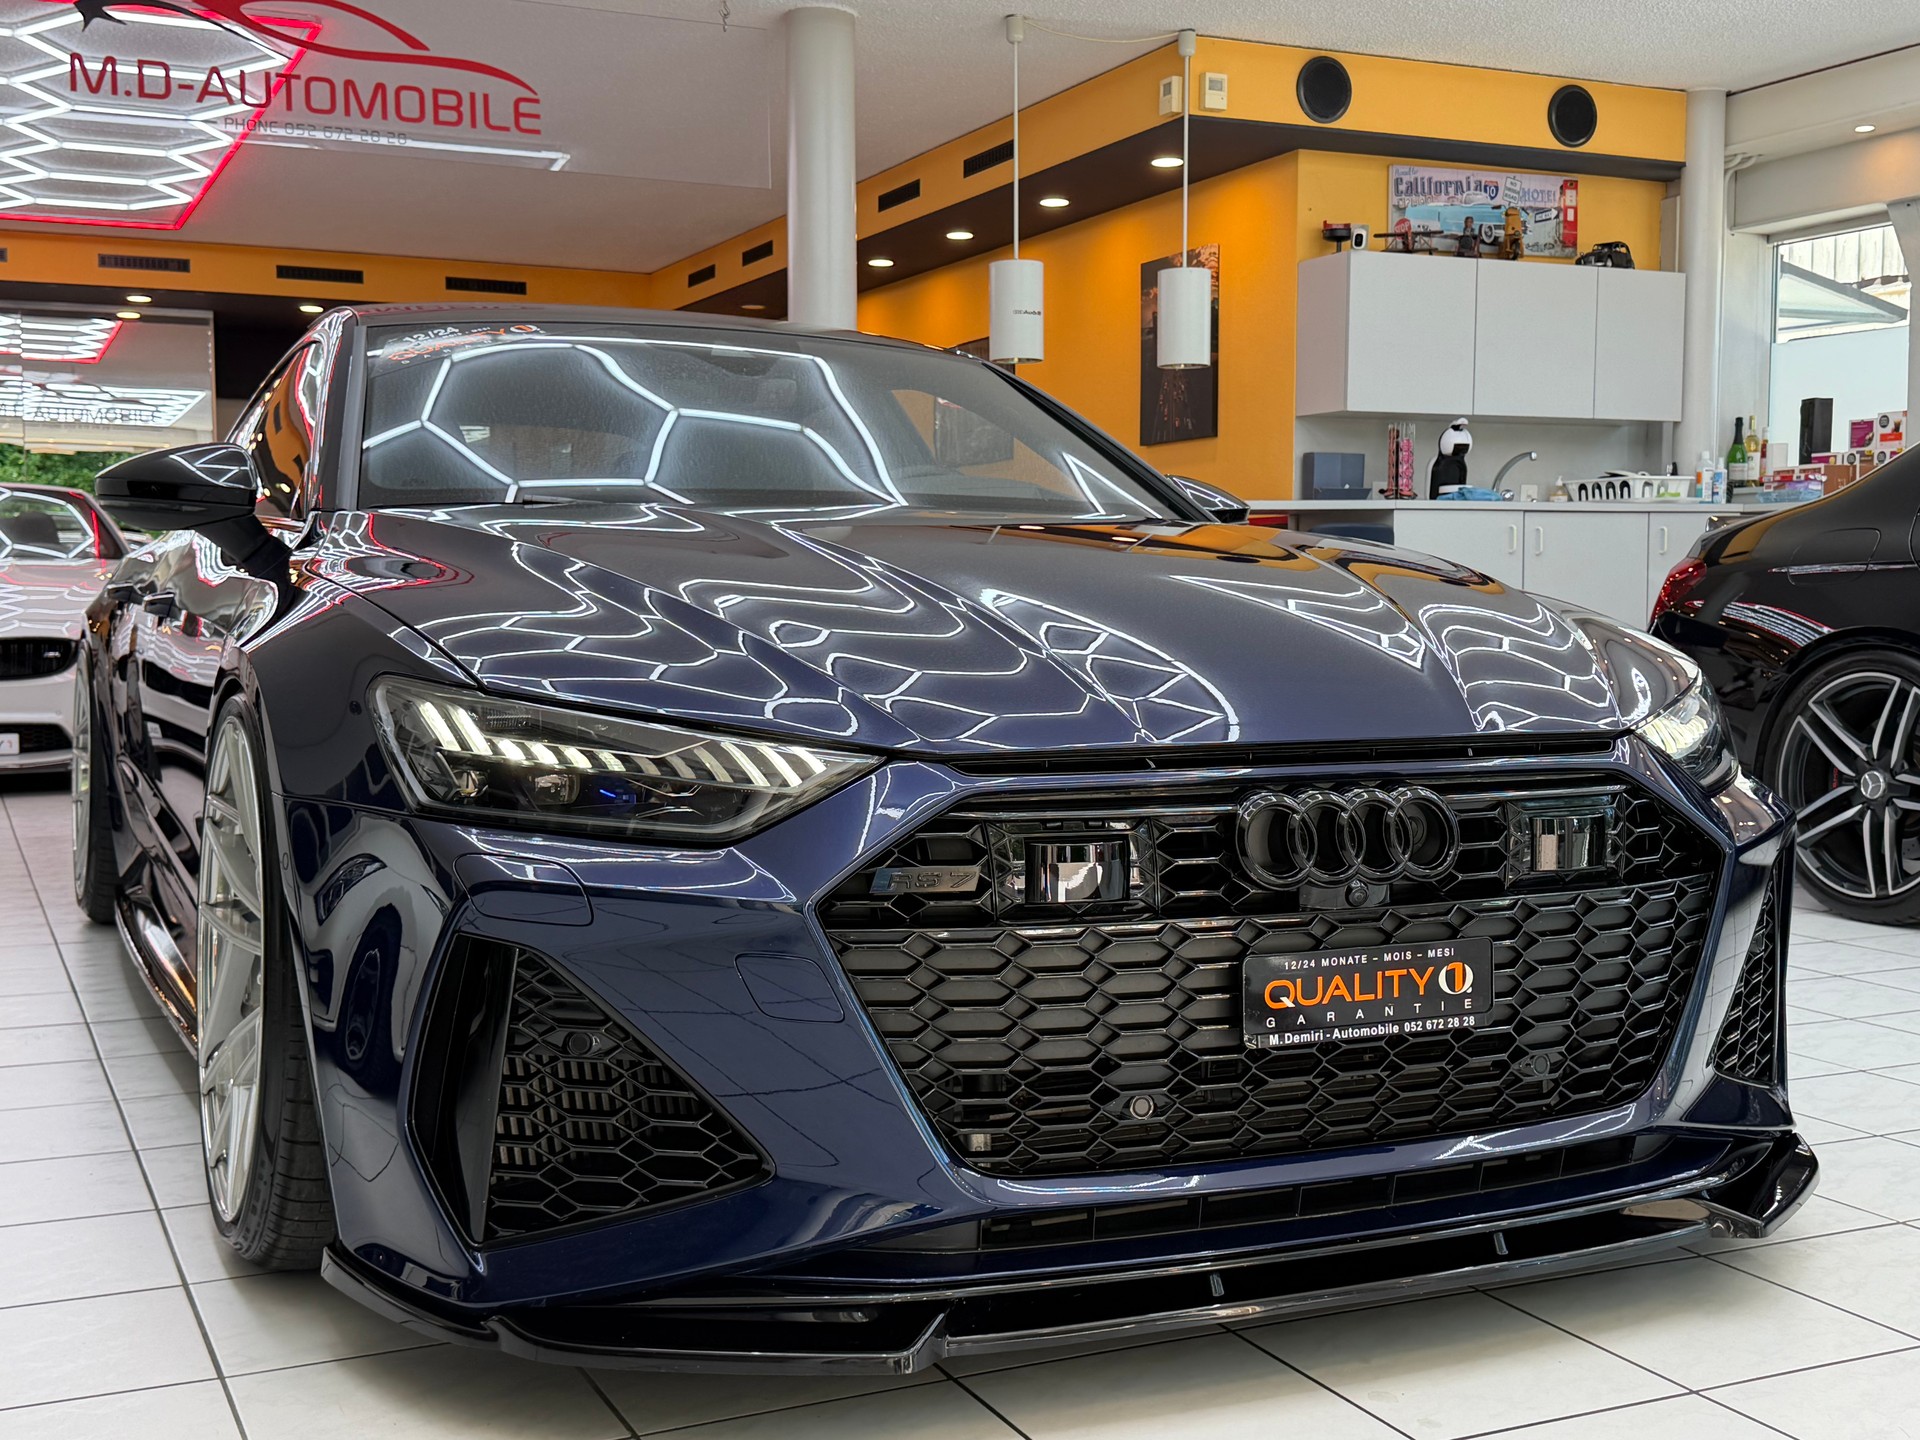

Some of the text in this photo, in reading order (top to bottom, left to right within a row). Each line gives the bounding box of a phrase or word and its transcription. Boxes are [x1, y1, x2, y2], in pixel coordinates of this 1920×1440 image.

[69, 52, 542, 136] M.D-AUTOMOBILE
[224, 117, 408, 145] PHONE 052 672 28 28
[1394, 176, 1483, 198] California
[1486, 186, 1496, 198] 10
[1394, 220, 1410, 233] STOP
[402, 327, 459, 344] 12/24
[1284, 959, 1316, 970] 12/24
[1321, 954, 1368, 967] MONATE
[1383, 950, 1412, 962] MOIS
[1428, 947, 1455, 958] MESI
[1264, 966, 1435, 1009] QUALITY
[1266, 998, 1472, 1028] GARANTIE
[1404, 1021, 1423, 1033] 052
[1426, 1018, 1445, 1031] 672
[1447, 1017, 1460, 1028] 28
[1463, 1015, 1475, 1027] 28
